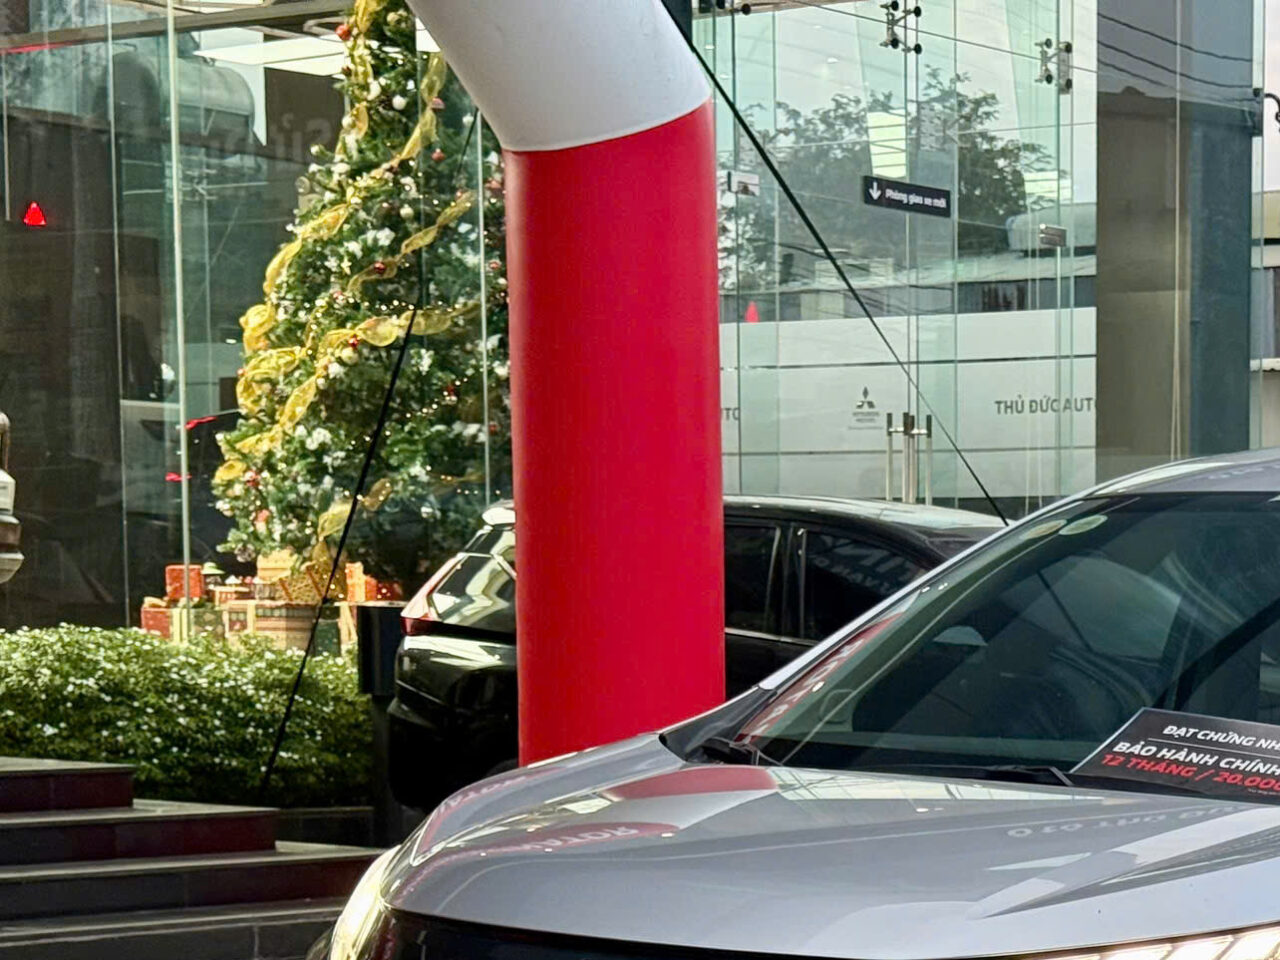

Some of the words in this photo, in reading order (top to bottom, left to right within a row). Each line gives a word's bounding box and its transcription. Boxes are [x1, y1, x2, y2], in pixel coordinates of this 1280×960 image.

[994, 394, 1025, 415] THỦ
[1028, 394, 1060, 414] ĐỨC
[1062, 397, 1096, 413] AUT
[1163, 726, 1199, 739] ĐẠT
[1112, 740, 1157, 757] BẢO
[1156, 747, 1218, 766] HÀNH
[1101, 754, 1126, 767] 12
[1126, 757, 1198, 778] THÁNG
